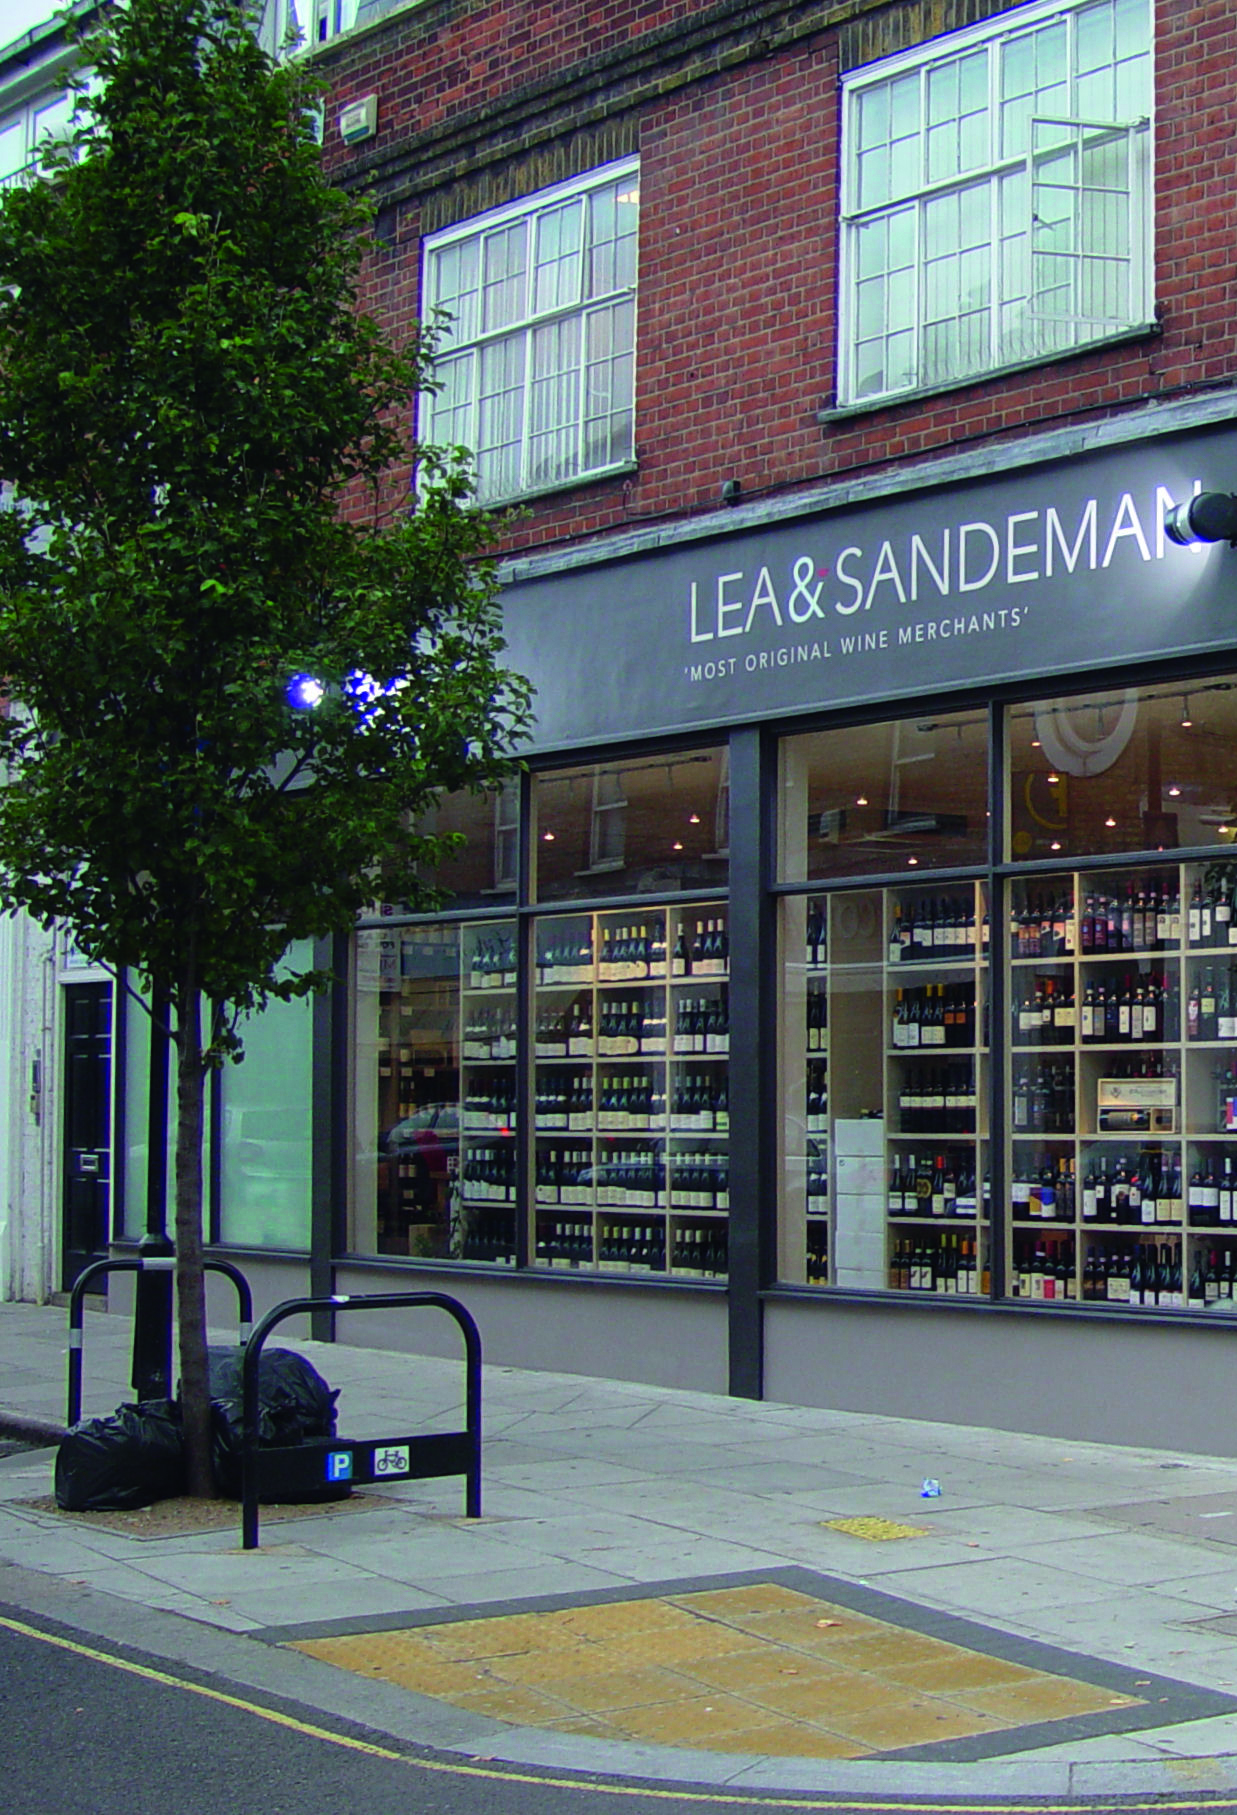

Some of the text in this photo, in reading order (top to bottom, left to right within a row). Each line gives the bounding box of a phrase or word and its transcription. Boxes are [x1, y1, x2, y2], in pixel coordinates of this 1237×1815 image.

[745, 641, 832, 672] ORIGINAL
[840, 630, 889, 655] WINE
[333, 1454, 350, 1478] P
